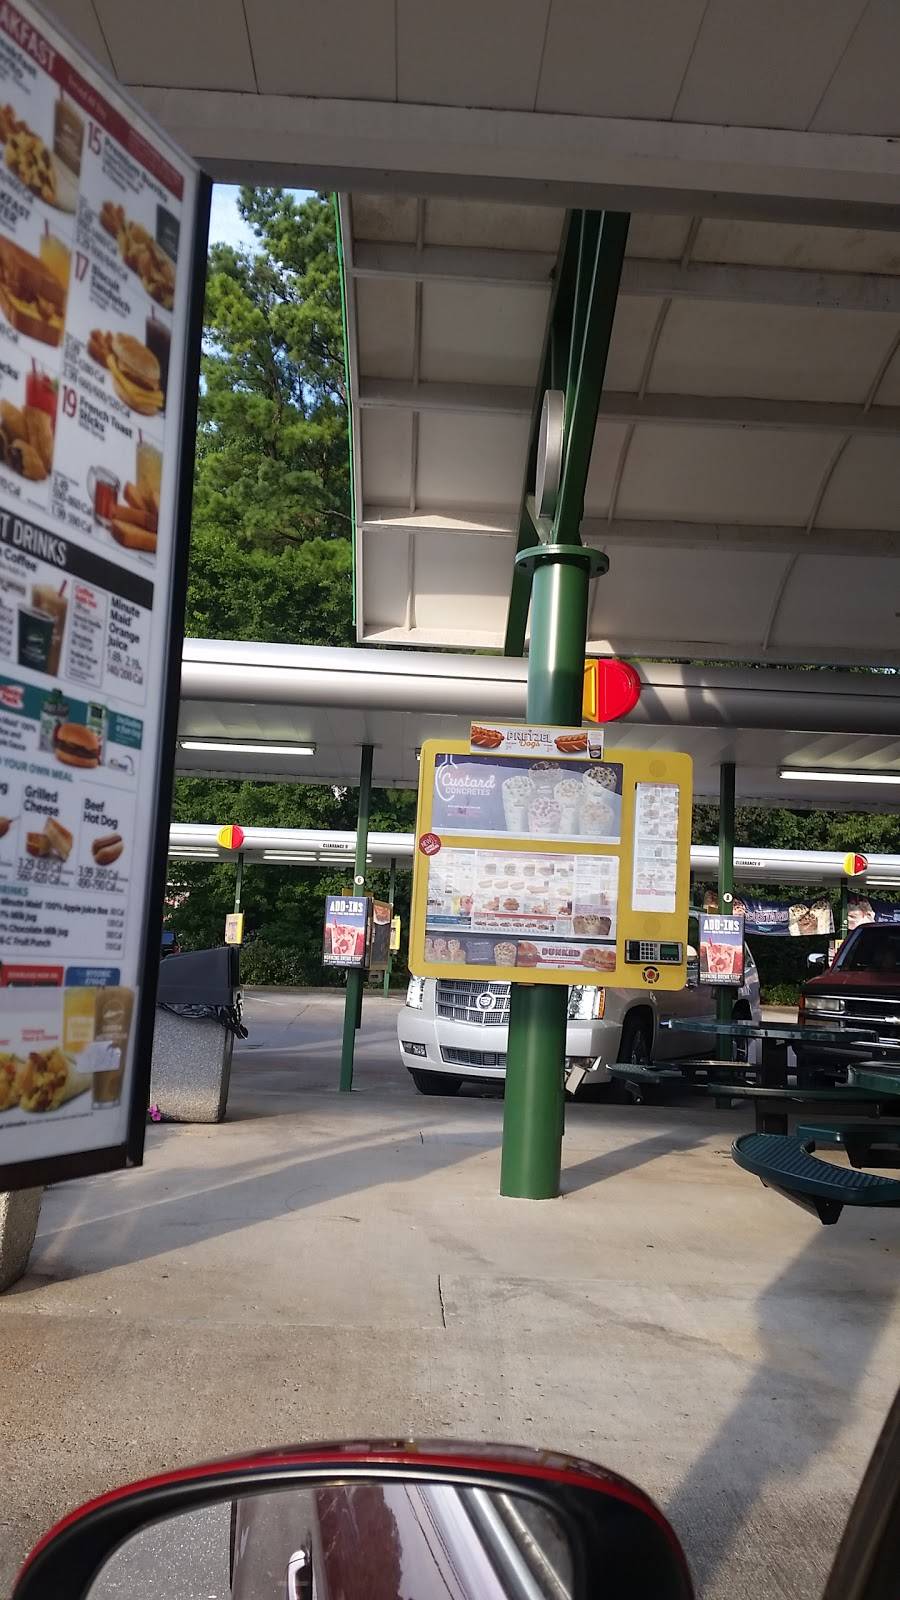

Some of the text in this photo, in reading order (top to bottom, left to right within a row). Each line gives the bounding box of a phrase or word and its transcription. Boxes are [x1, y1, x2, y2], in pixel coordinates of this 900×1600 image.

[88, 121, 102, 155] 15
[75, 251, 89, 282] 17
[62, 384, 78, 417] 19
[13, 519, 67, 566] DRINKS
[111, 597, 140, 618] Minute
[109, 622, 140, 643] Orange
[107, 635, 128, 651] Juice
[506, 730, 553, 743] PRETZEL
[519, 740, 540, 750] Dogs
[441, 773, 496, 789] Custard
[25, 786, 59, 803] Grilled
[445, 787, 491, 796] CONCRETES
[23, 800, 59, 817] Cheese
[84, 799, 104, 812] Beef
[83, 813, 118, 831] Hot Dog
